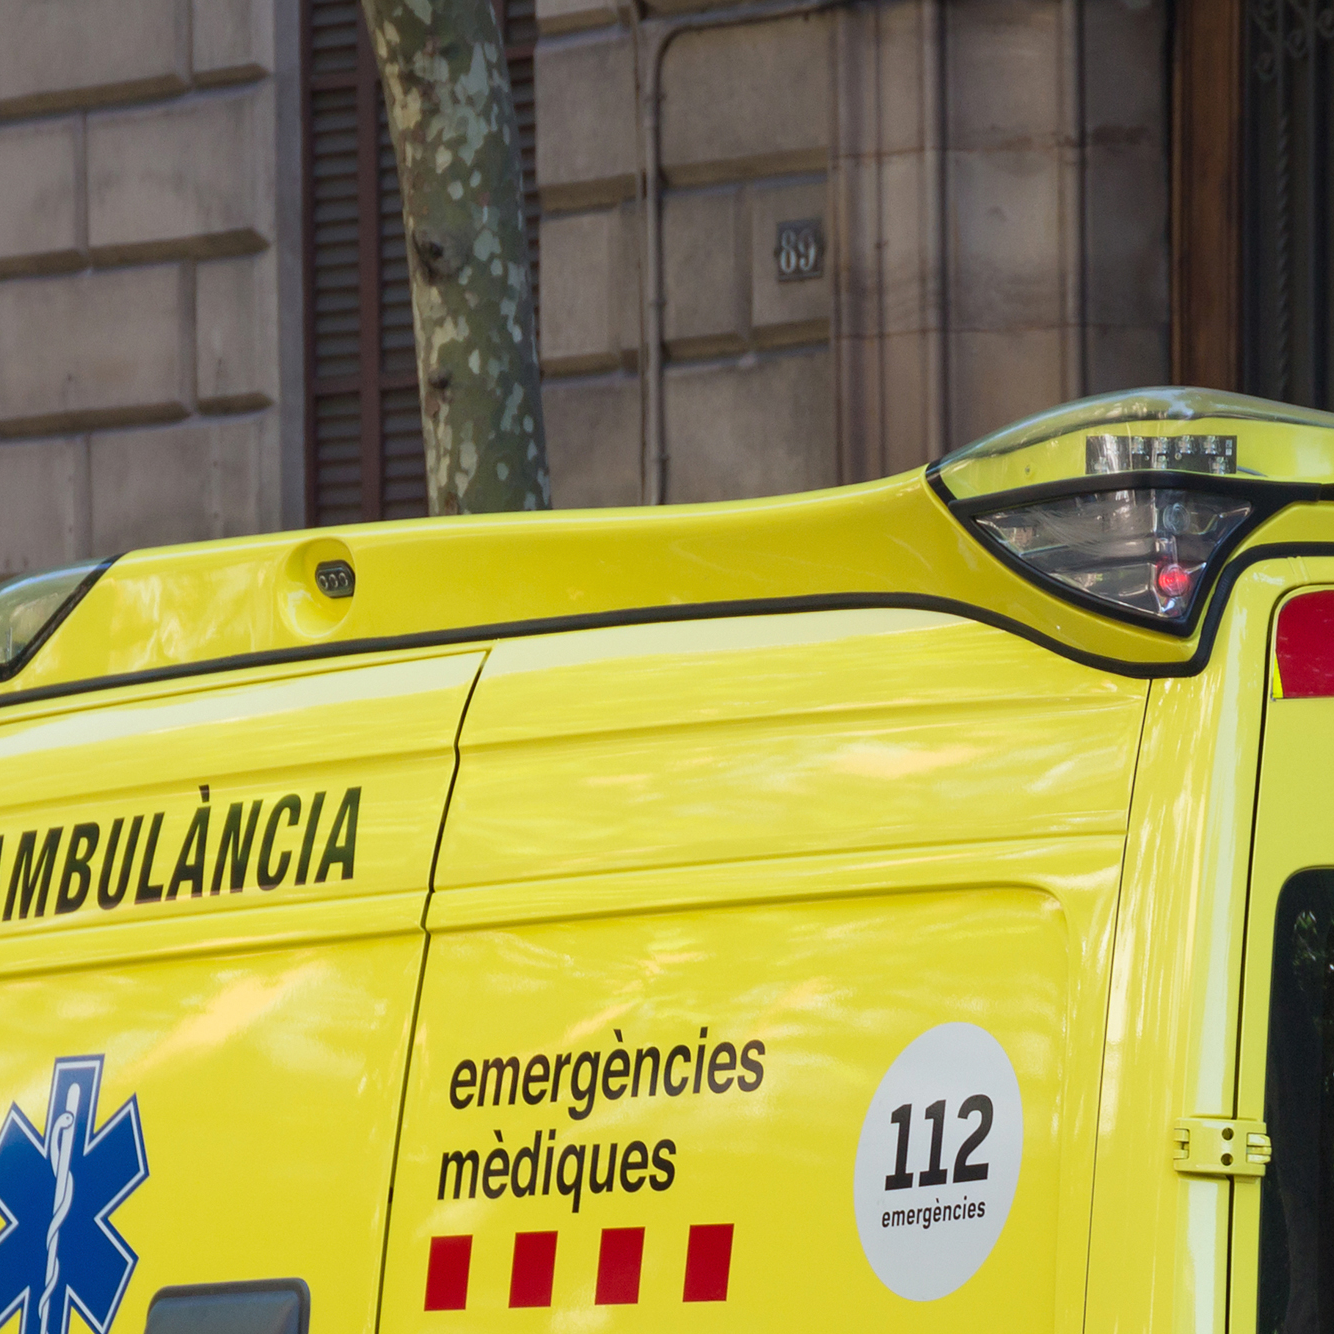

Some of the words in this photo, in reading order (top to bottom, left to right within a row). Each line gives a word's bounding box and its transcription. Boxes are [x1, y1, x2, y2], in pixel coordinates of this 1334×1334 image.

[780, 228, 816, 274] 89
[449, 1027, 766, 1120] emergències
[437, 1130, 677, 1213] mèdiques
[884, 1093, 994, 1192] 112
[880, 1197, 986, 1231] emergències
